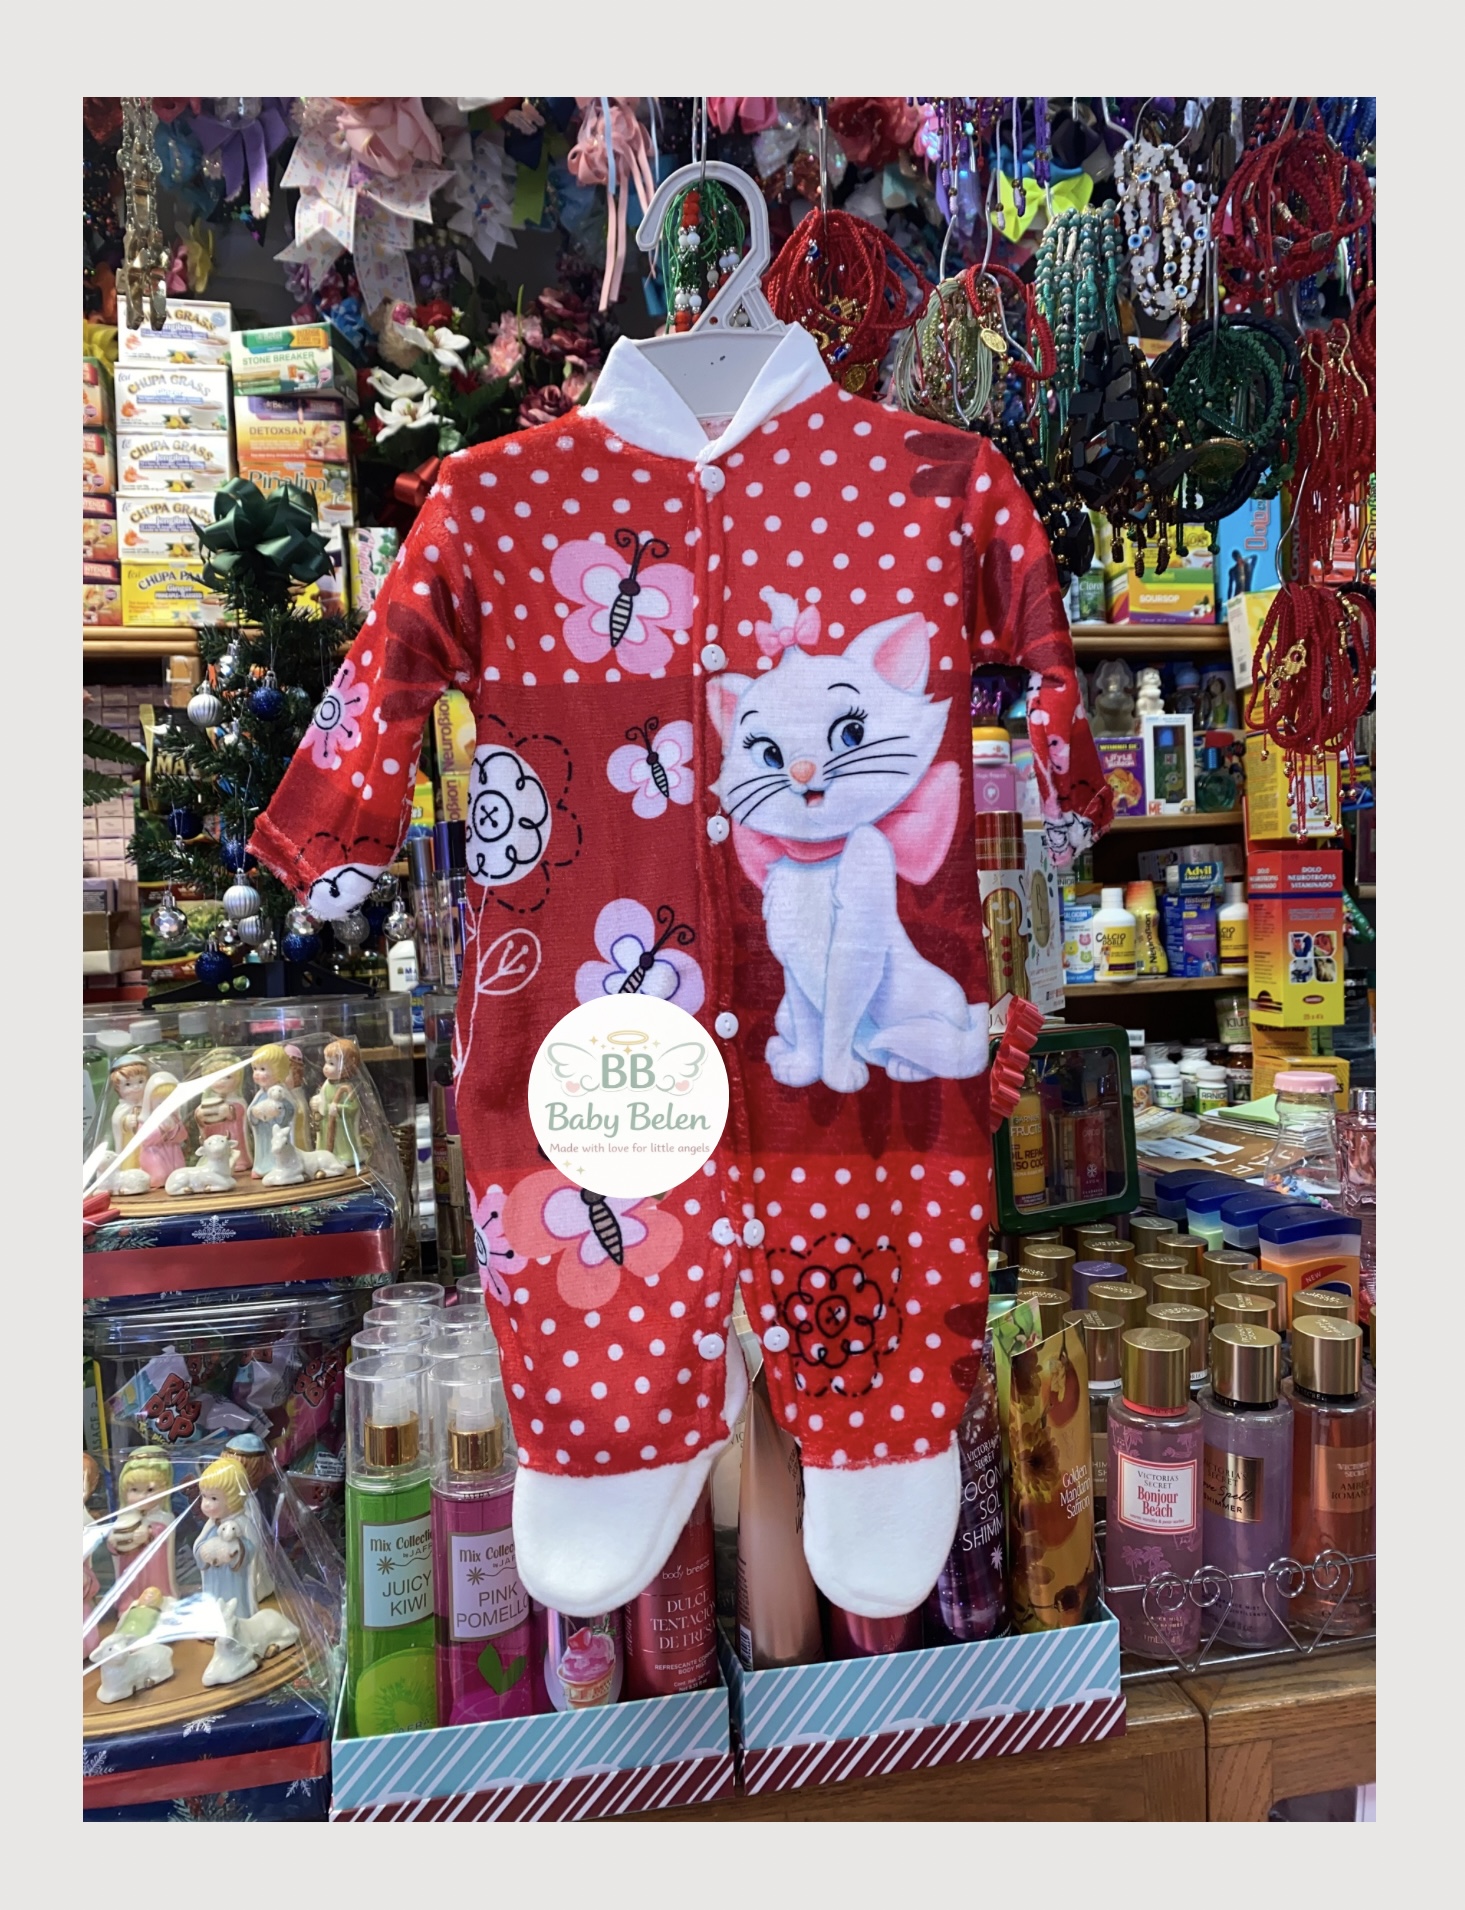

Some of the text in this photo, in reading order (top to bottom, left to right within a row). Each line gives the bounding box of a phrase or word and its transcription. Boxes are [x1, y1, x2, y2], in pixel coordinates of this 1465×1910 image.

[242, 351, 315, 366] STONE BREAKER
[127, 375, 211, 397] CHUPA GRASS
[249, 426, 306, 436] DETOXSAN
[129, 440, 214, 461] CHUPA GRASS
[130, 503, 170, 523] CHUPA
[138, 571, 177, 590] CHUPA
[1139, 594, 1180, 604] SOURSOP
[157, 754, 187, 776] MA
[1185, 865, 1212, 876] Advil
[1095, 931, 1127, 943] CALCIO
[1305, 1271, 1322, 1284] NEW
[974, 1450, 996, 1472] SECRET
[1062, 1464, 1088, 1488] Golden
[1144, 1480, 1172, 1489] SECRET
[1208, 1471, 1239, 1487] SECRET
[1060, 1476, 1091, 1507] Mandarin
[1137, 1486, 1179, 1506] Bonjour
[1202, 1481, 1255, 1503] ove Spell
[1066, 1495, 1091, 1520] Saffron
[1142, 1501, 1174, 1518] Beach
[1202, 1493, 1243, 1514] SHIMMER
[370, 1538, 391, 1552] Mix
[459, 1543, 515, 1563] Mix Collec
[499, 1554, 517, 1568] JAF
[662, 1559, 711, 1580] body breeze
[382, 1569, 432, 1598] JUICY
[479, 1582, 518, 1607] PINK
[667, 1589, 710, 1613] DULCE
[390, 1593, 427, 1617] KIWI
[659, 1636, 680, 1650] DE
[654, 1659, 697, 1671] REFRESCANTE
[678, 1666, 694, 1675] BODY
